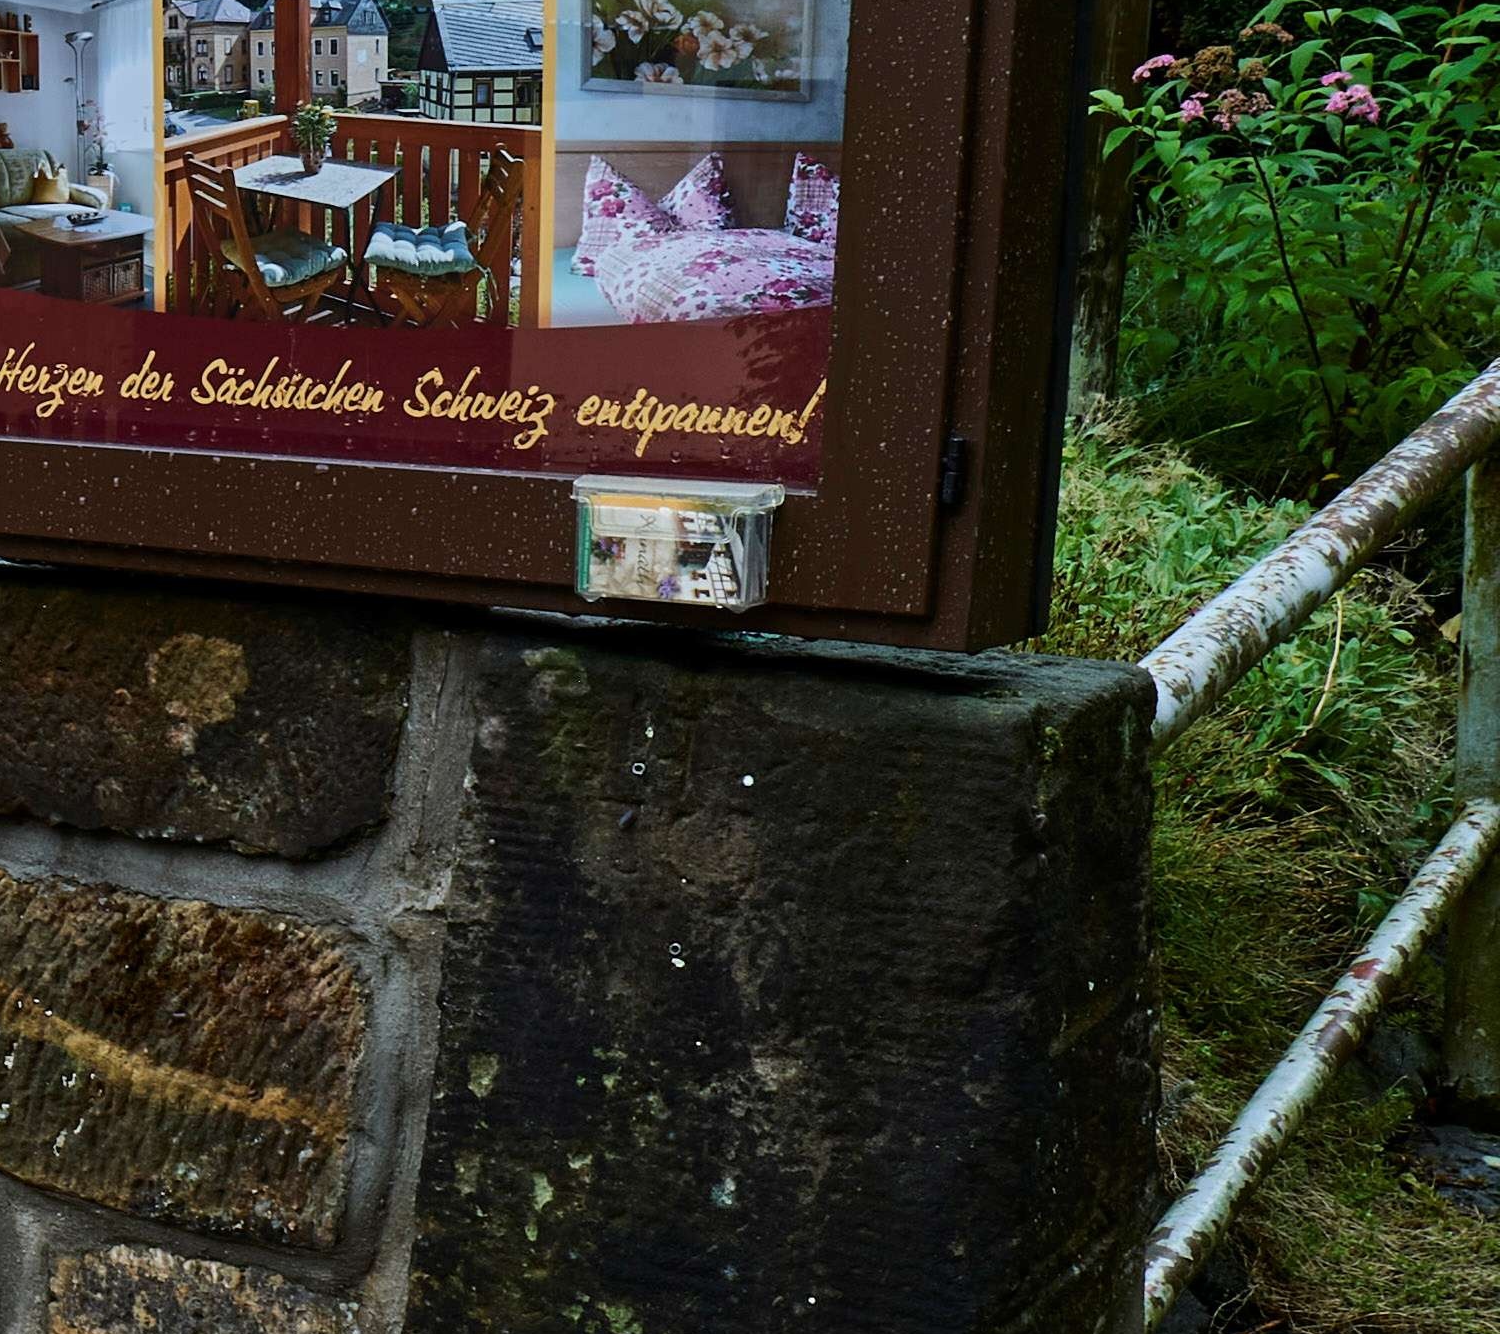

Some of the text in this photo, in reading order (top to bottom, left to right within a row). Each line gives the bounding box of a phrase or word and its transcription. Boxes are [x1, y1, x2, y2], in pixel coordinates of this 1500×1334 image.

[120, 349, 176, 402] der
[189, 355, 386, 413] Sächsischen
[402, 365, 557, 450] Schweiz
[575, 377, 828, 458] entspannen!
